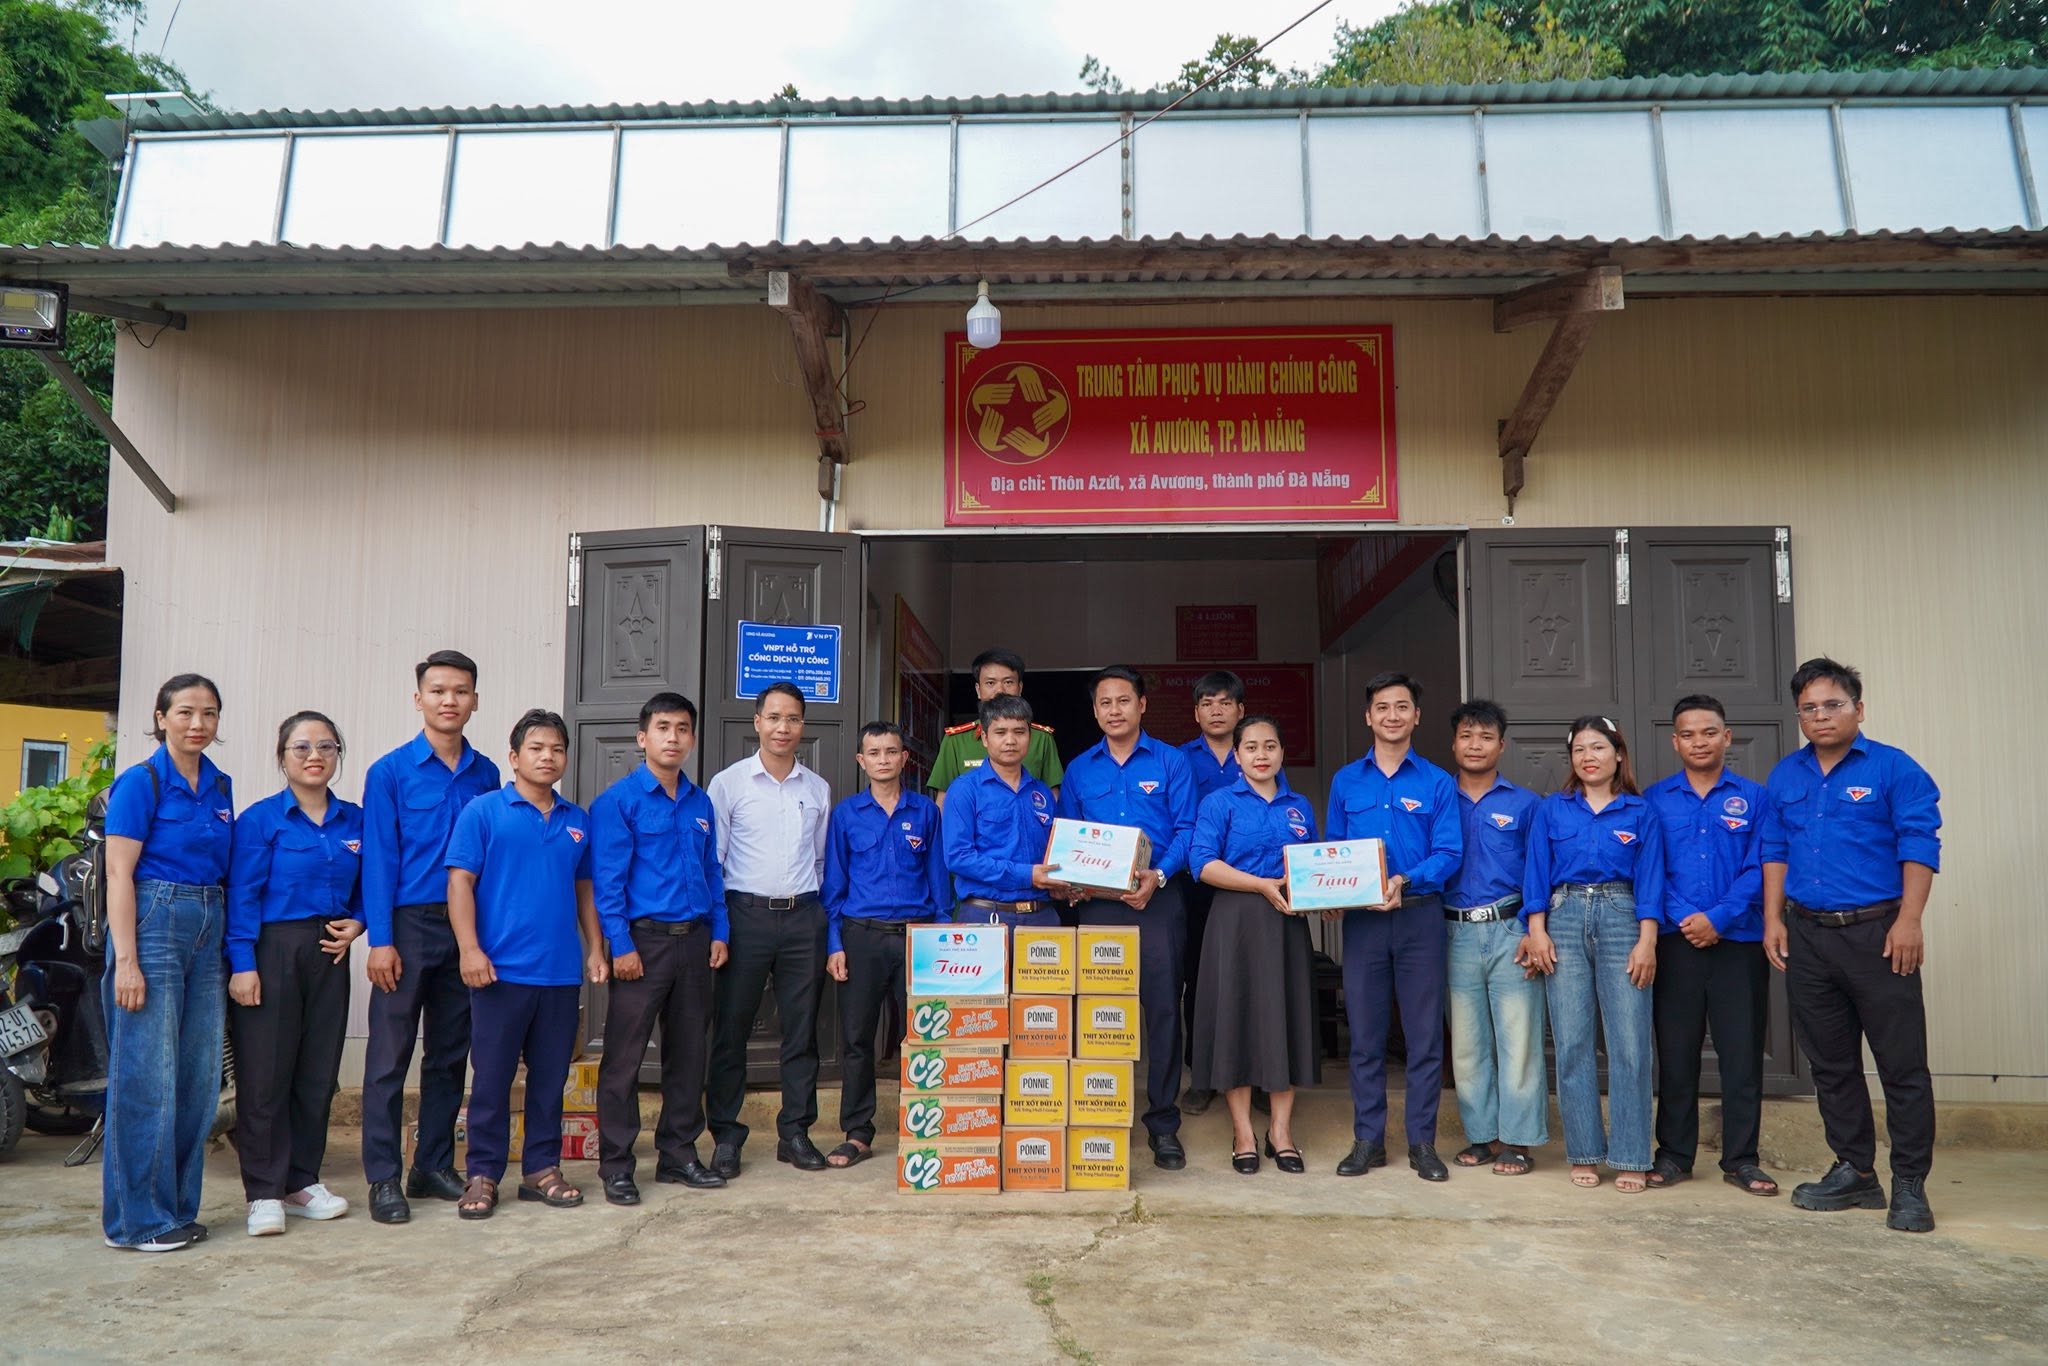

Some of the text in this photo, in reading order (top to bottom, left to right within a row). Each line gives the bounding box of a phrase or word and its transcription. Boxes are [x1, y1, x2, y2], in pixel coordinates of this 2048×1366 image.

[1076, 353, 1358, 403] TRUNG TÂM PHỤC VỤ HÀNH CHÍNH CÔNG
[1130, 407, 1305, 457] XÃ AVƯƠNG, TP. ĐÀ NẴNG
[991, 469, 1350, 495] Địa chỉ: Thôn Azứt, xã Avương, thành phố Đà Nẵng
[763, 644, 784, 652] VNPT
[799, 645, 816, 655] TRỢ
[773, 655, 792, 664] DỊCH
[794, 656, 805, 665] VỤ
[807, 656, 829, 665] CÔNG
[1310, 873, 1359, 890] Tặng
[933, 959, 983, 977] Tặng
[0, 1009, 27, 1035] 2-U1
[913, 1005, 951, 1040] C2
[908, 1053, 946, 1089] C2
[906, 1102, 944, 1138] C2
[904, 1153, 942, 1190] C2
